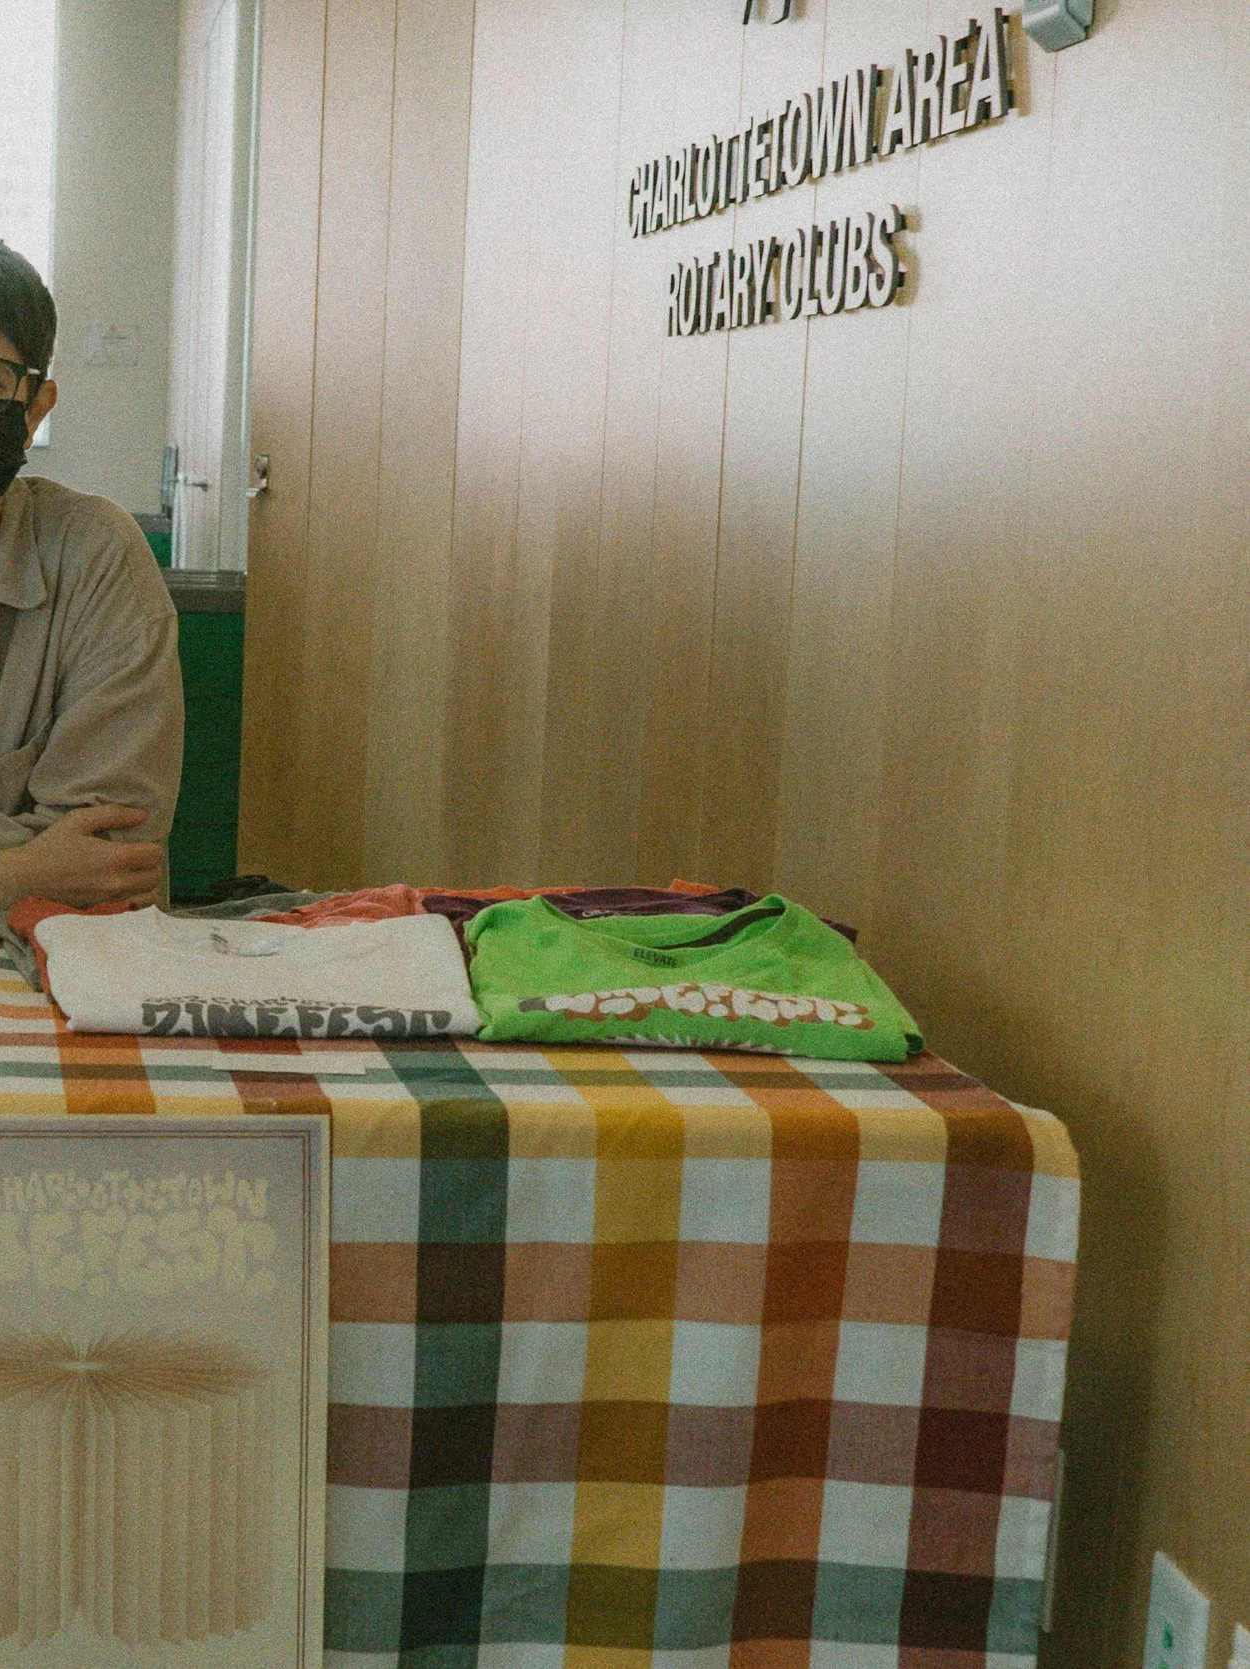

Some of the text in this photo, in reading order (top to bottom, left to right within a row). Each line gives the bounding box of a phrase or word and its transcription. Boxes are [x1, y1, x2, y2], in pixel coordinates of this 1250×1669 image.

[629, 8, 1014, 238] CHARLOTTETOWN AREA
[666, 203, 906, 337] ROTARY CLUBS
[632, 946, 679, 969] ELEVATE
